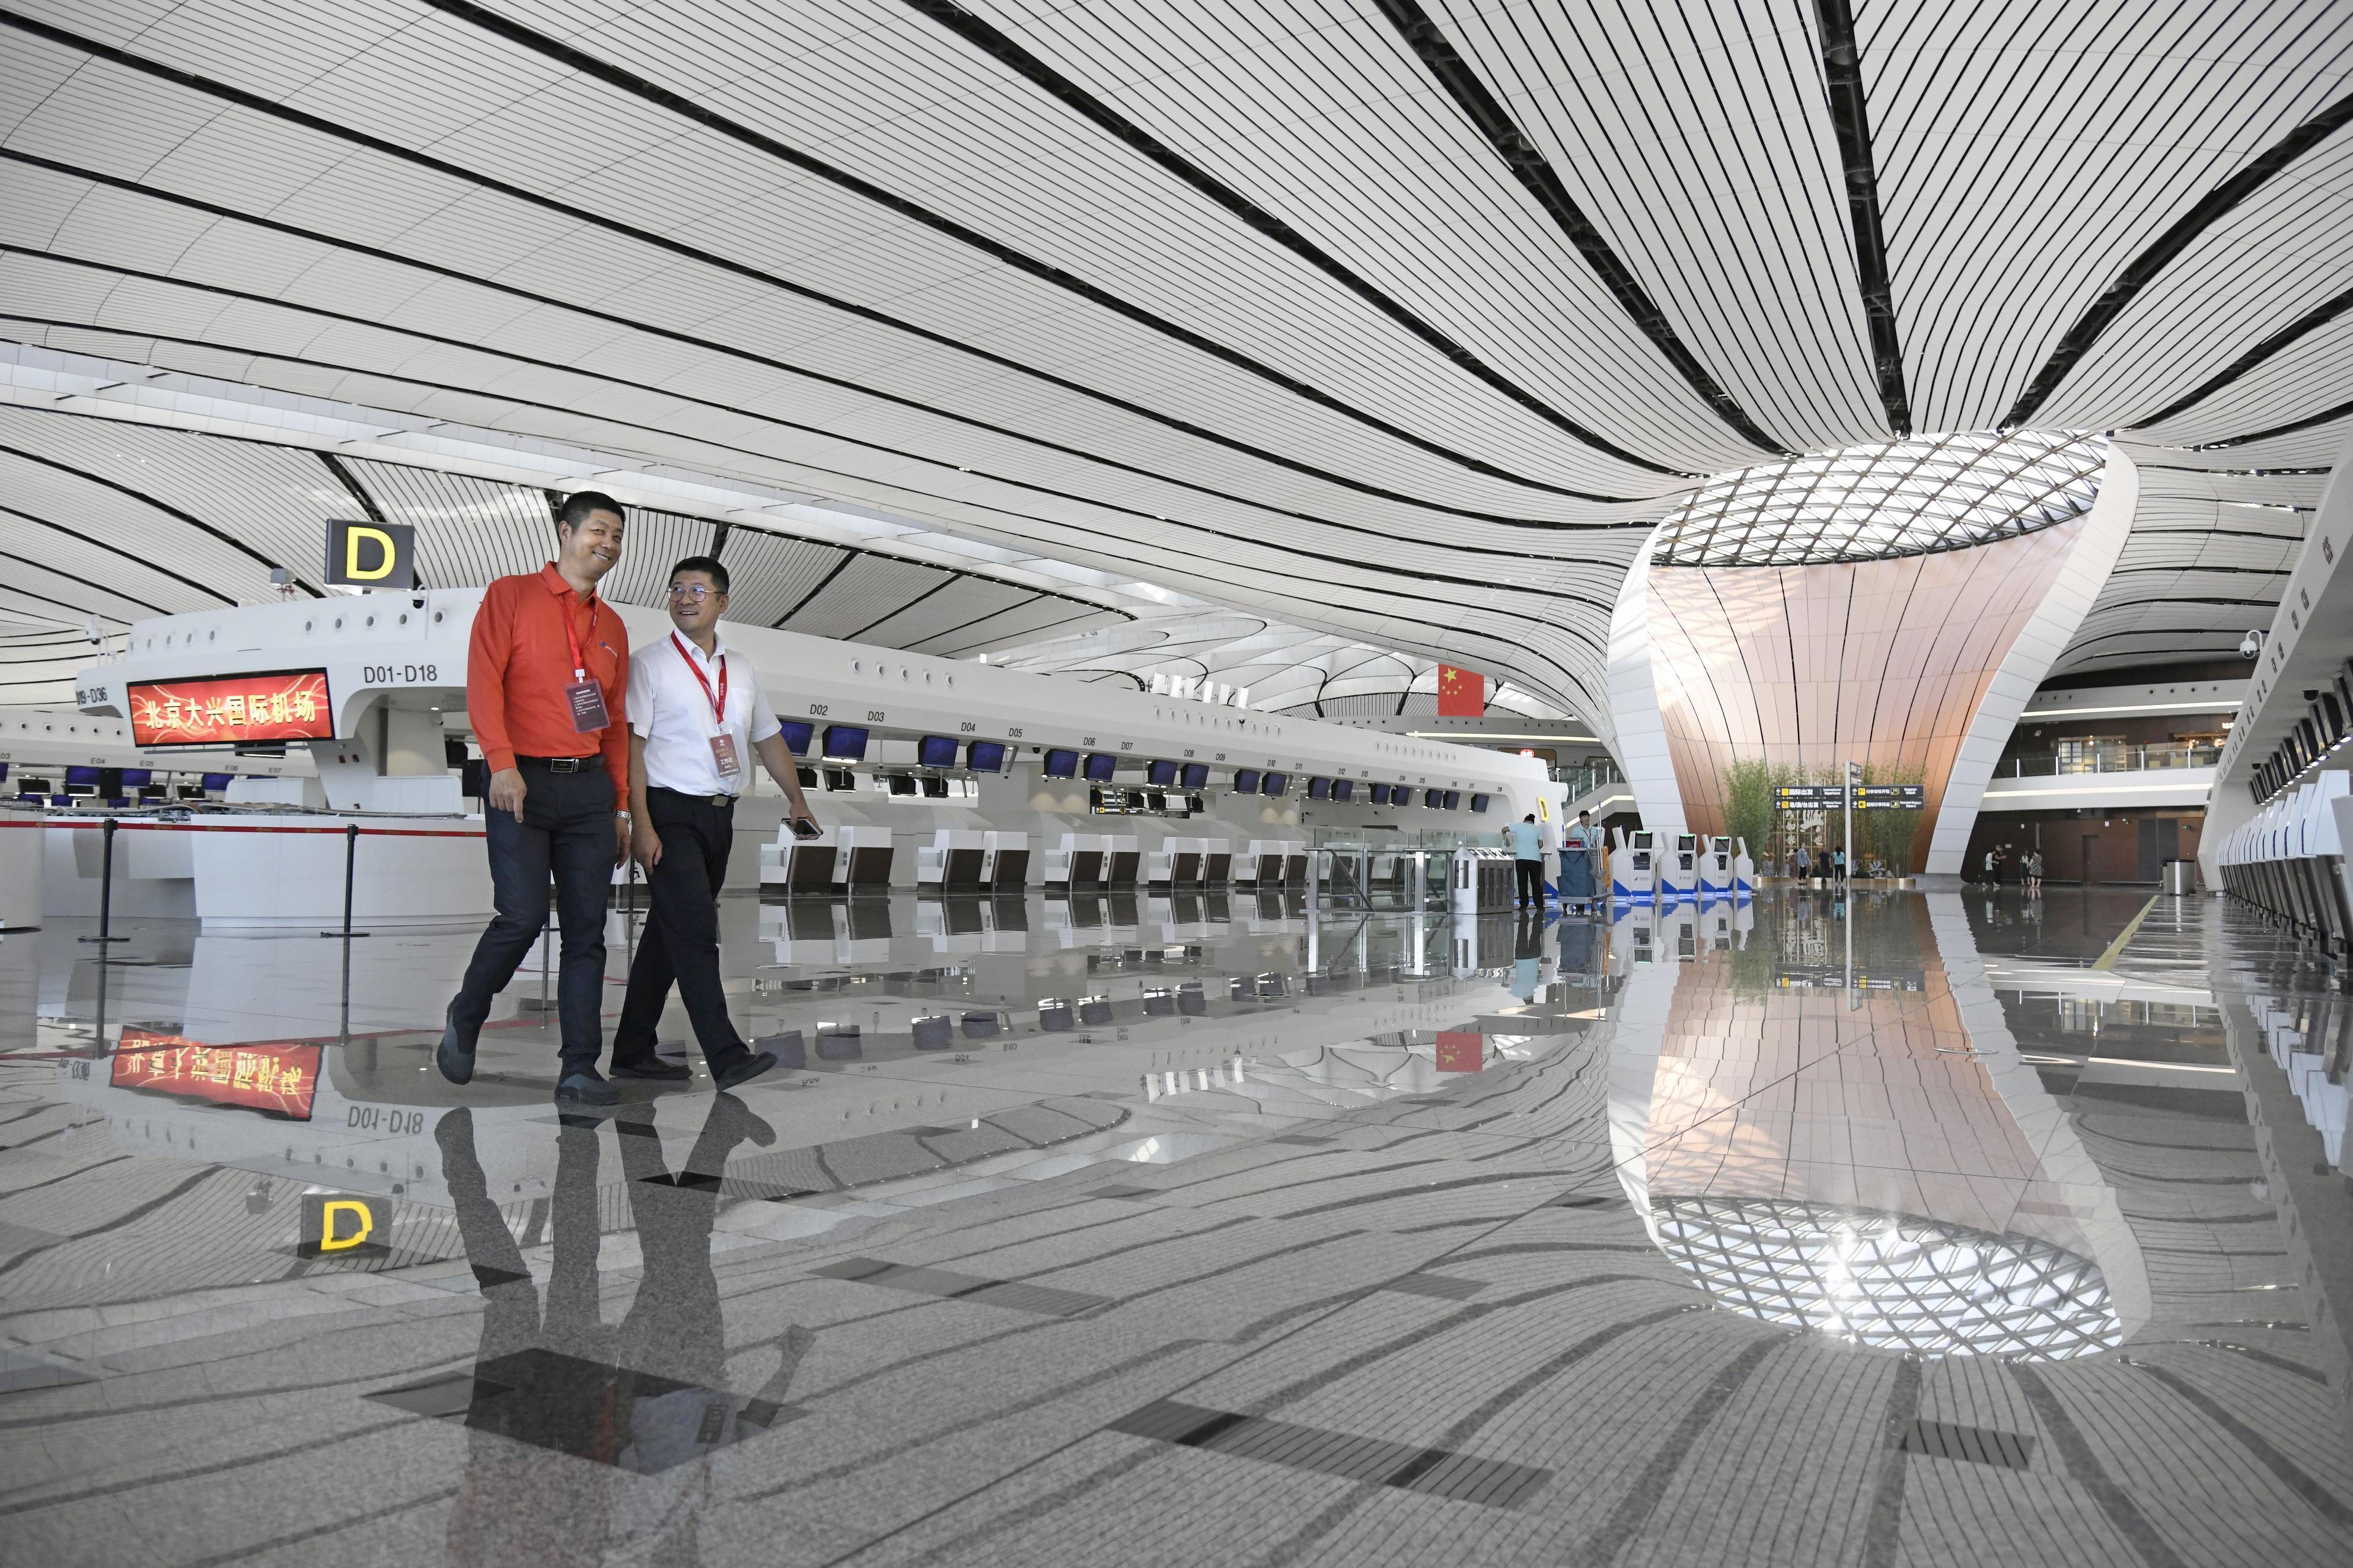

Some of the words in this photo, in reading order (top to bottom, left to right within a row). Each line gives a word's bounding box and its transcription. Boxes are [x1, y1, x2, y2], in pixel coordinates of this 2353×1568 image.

[346, 526, 396, 580] D
[364, 665, 437, 683] D01-D18
[145, 690, 315, 729] 北京大兴国际机场
[809, 704, 828, 716] D02
[868, 711, 884, 722] D03
[961, 721, 975, 732] D04
[1009, 727, 1022, 738] D05
[1083, 736, 1095, 746] D06
[1121, 742, 1133, 751] D07
[1184, 749, 1194, 757] D08
[1216, 753, 1225, 761] D09
[1538, 796, 1549, 821] D
